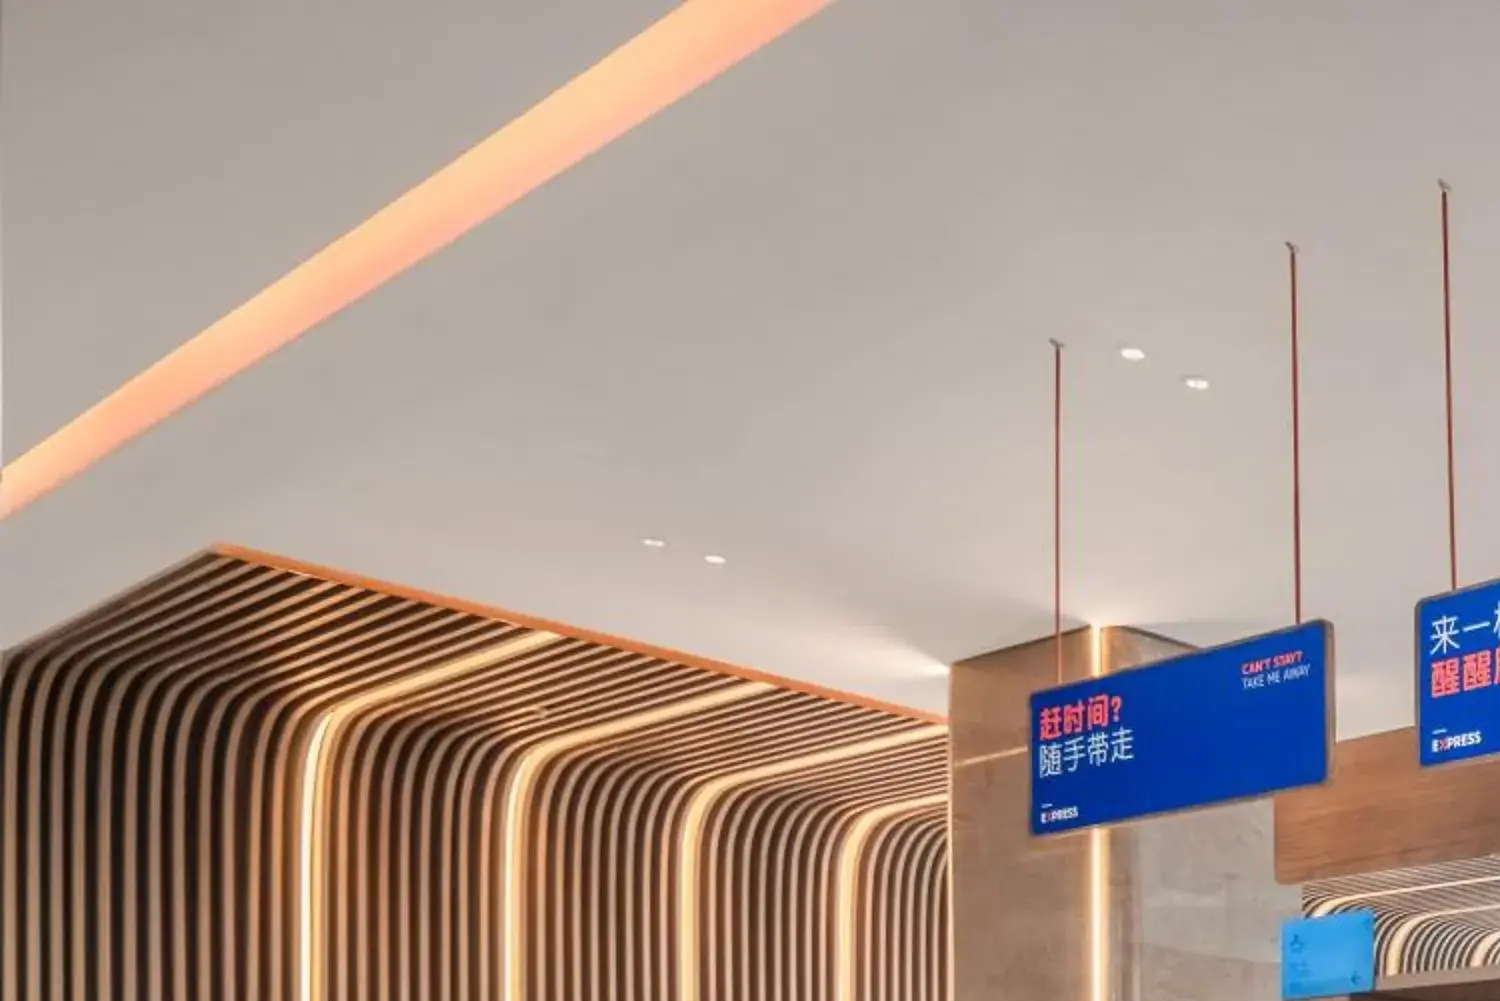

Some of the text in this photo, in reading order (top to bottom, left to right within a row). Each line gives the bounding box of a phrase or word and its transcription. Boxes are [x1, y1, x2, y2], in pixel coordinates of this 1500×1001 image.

[1243, 663, 1311, 689] TAKE ME AWAY
[1039, 726, 1135, 778] 随手带走
[1431, 730, 1481, 752] EXPRESS
[1041, 805, 1079, 824] EXPRESS
